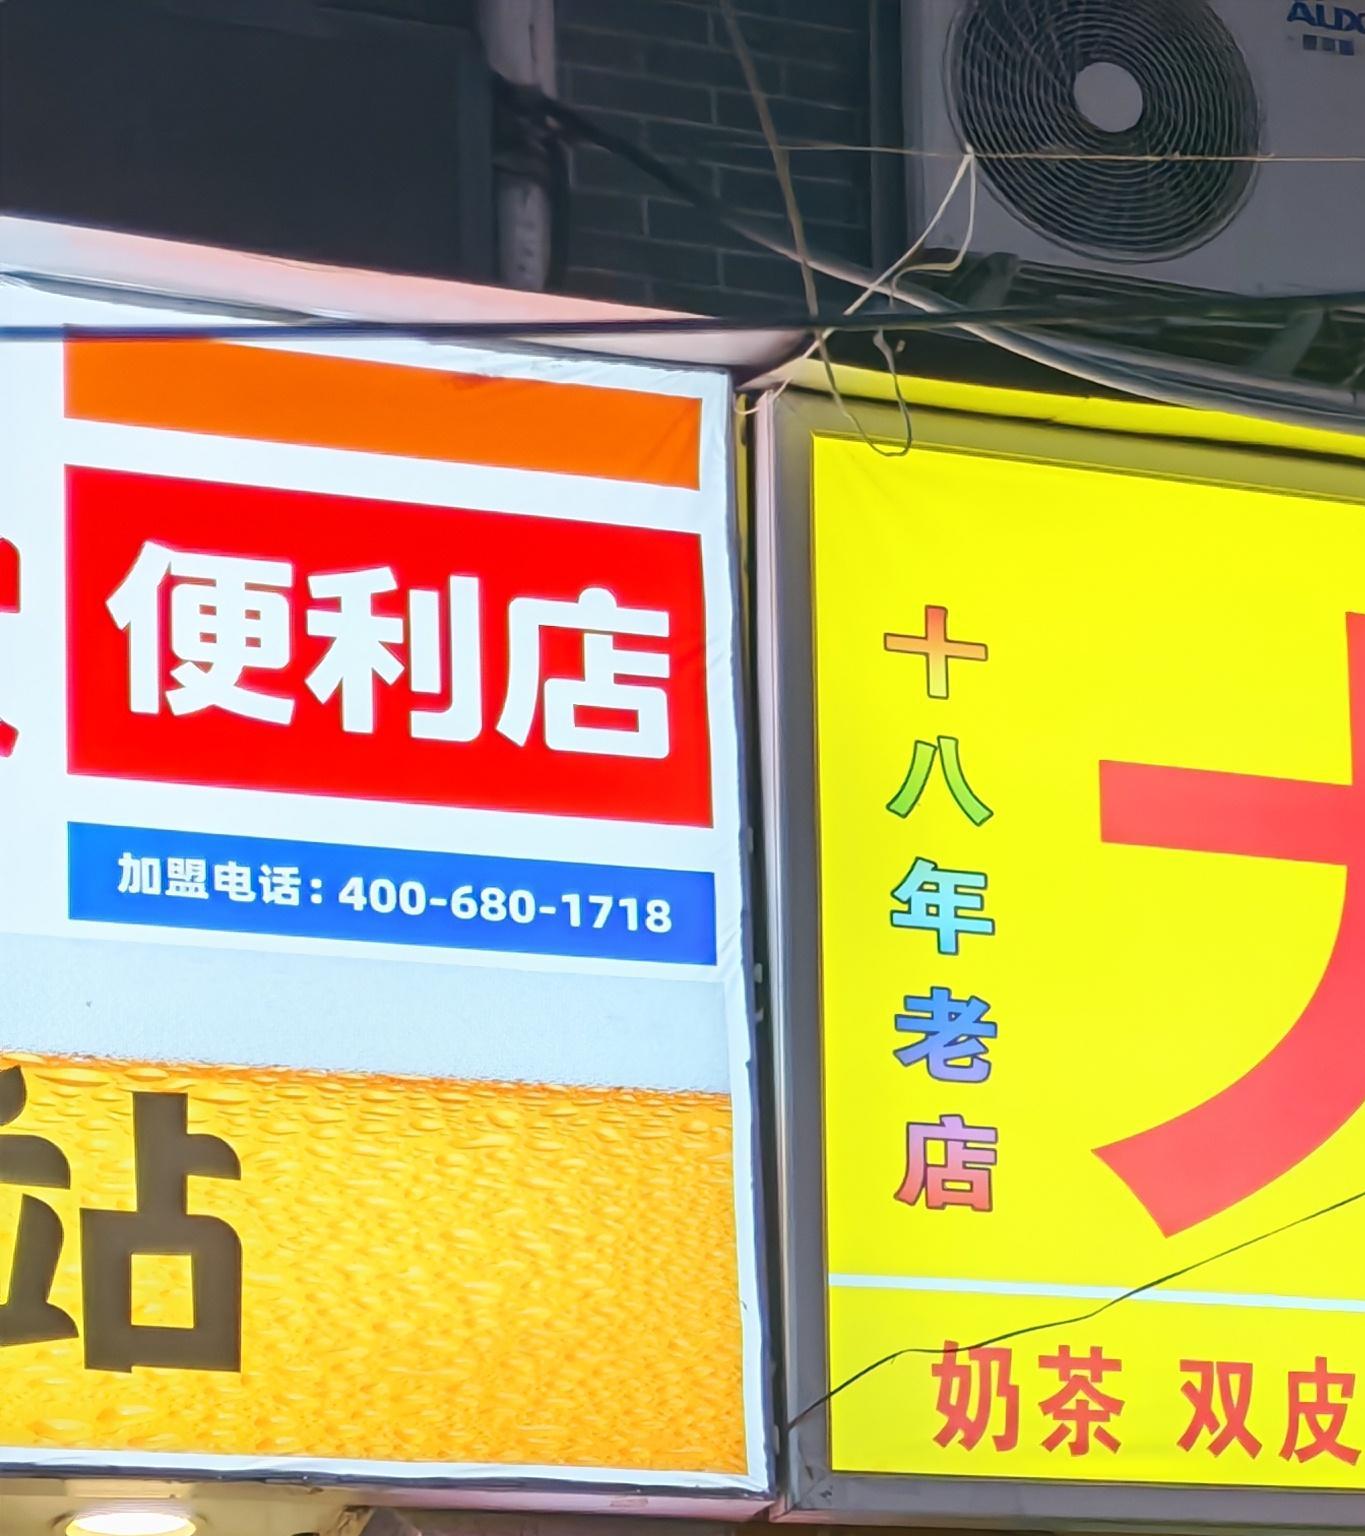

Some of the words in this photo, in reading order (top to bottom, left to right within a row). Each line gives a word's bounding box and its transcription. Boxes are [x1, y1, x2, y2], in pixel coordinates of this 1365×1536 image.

[105, 541, 670, 759] 便利店
[884, 605, 997, 1212] 十八年老店
[0, 1065, 242, 1373] 站
[932, 1340, 1126, 1456] 奶茶
